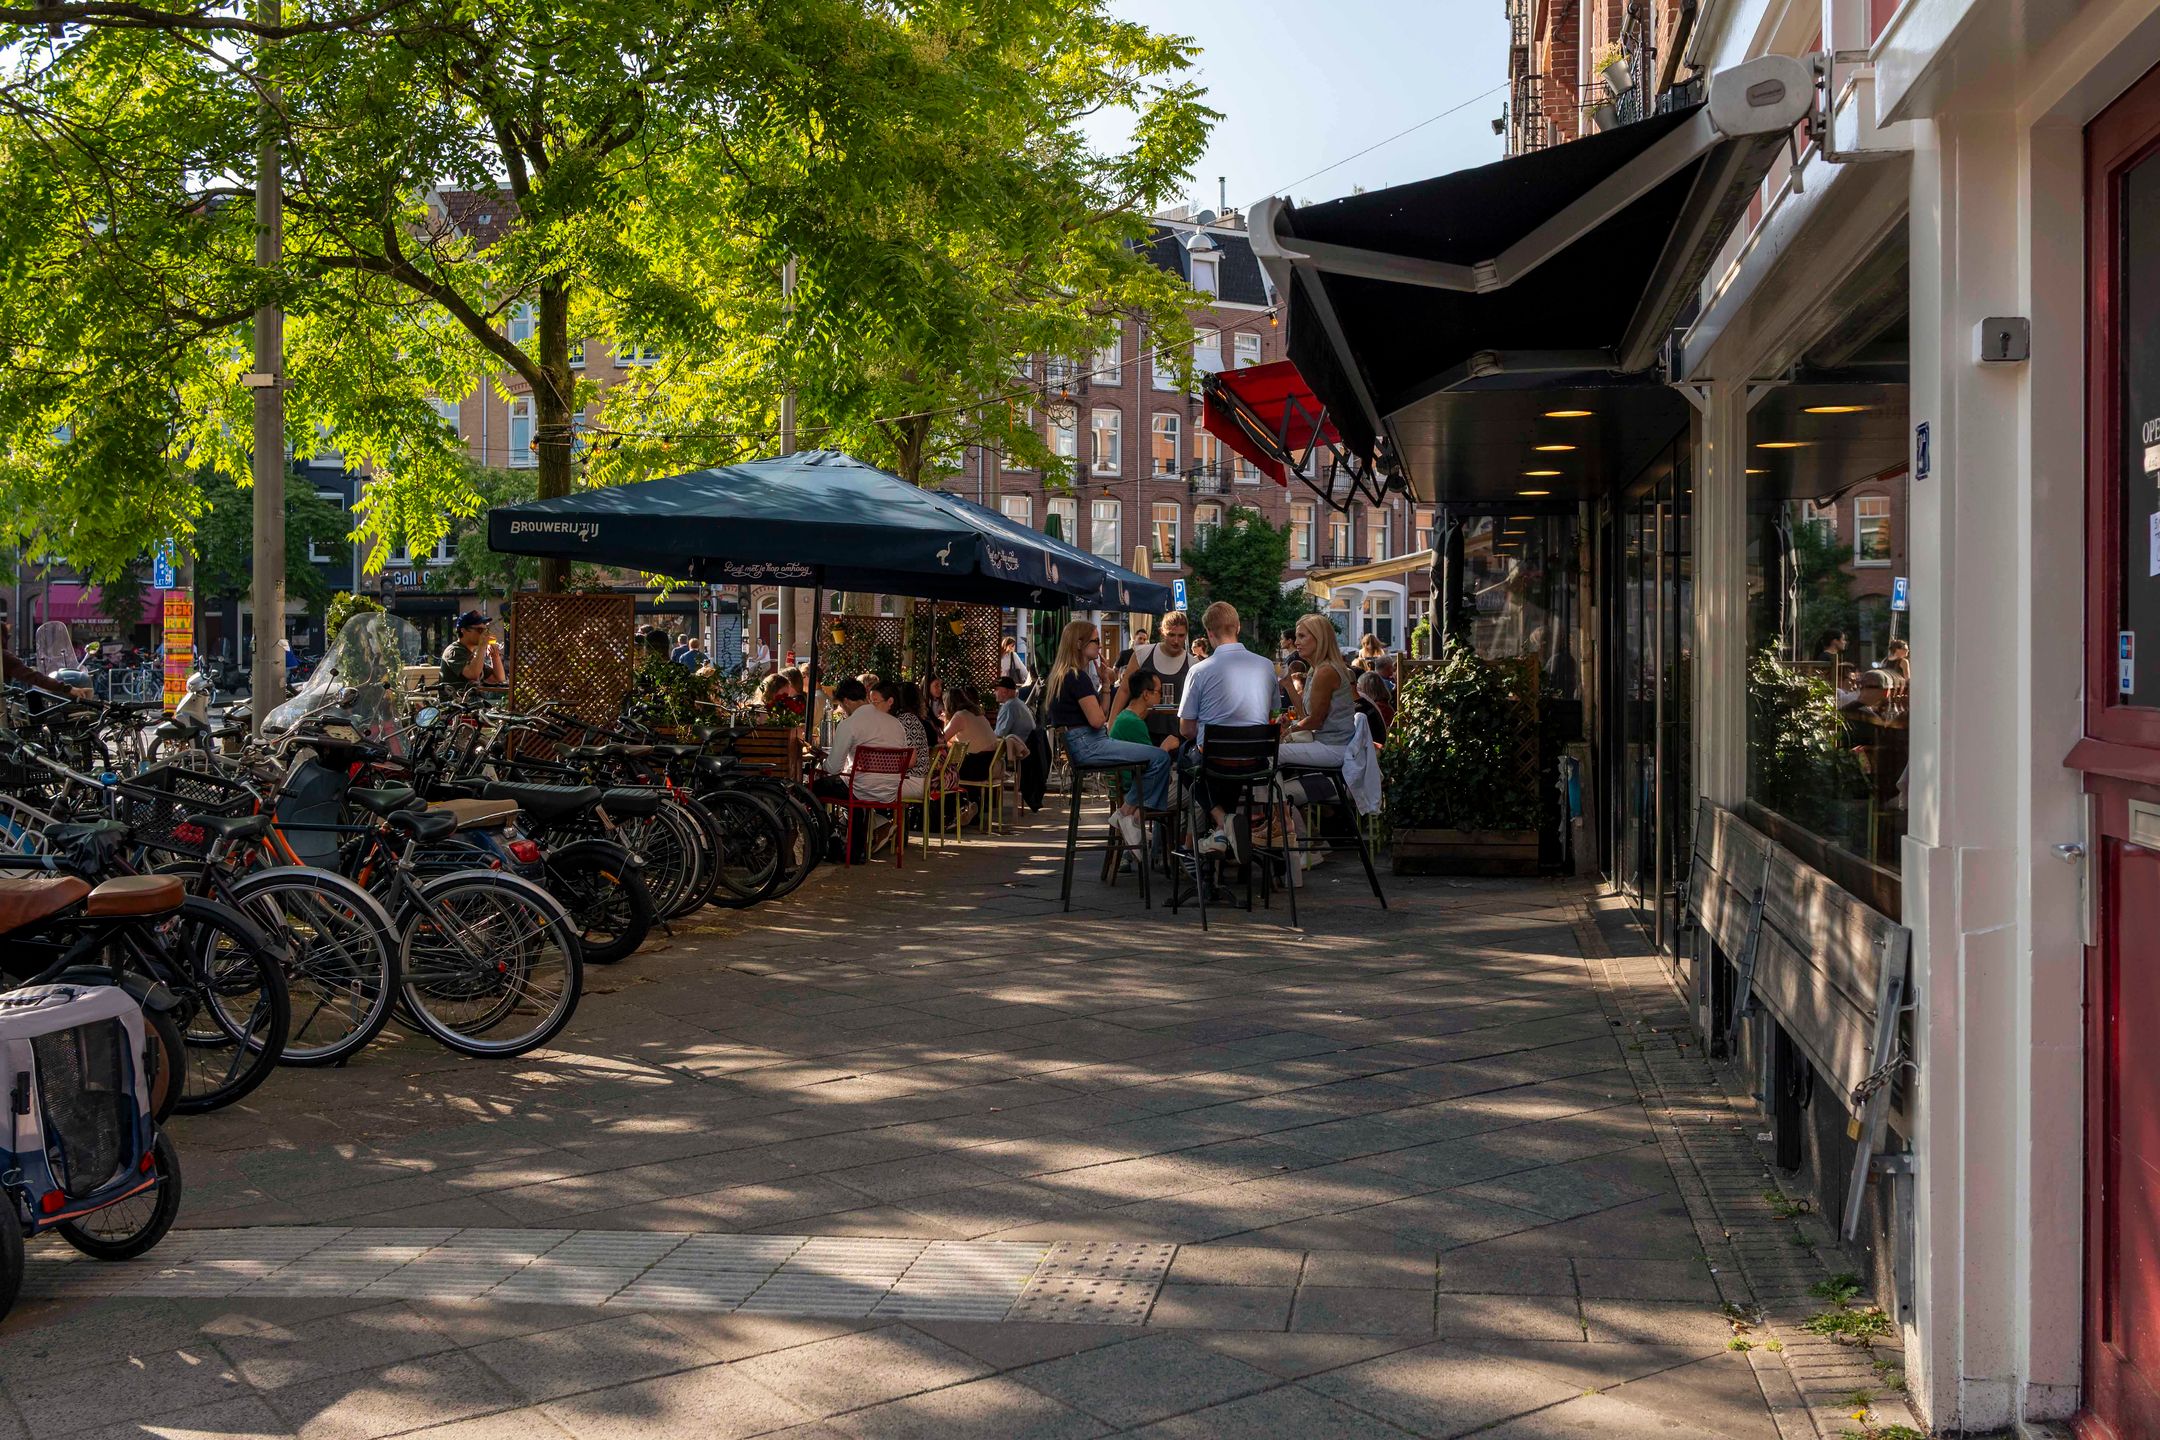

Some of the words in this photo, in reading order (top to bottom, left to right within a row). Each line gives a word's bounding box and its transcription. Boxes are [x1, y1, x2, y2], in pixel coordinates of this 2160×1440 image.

[510, 521, 578, 534] BROUWERIJ
[394, 571, 416, 584] Gall
[1175, 582, 1183, 598] P
